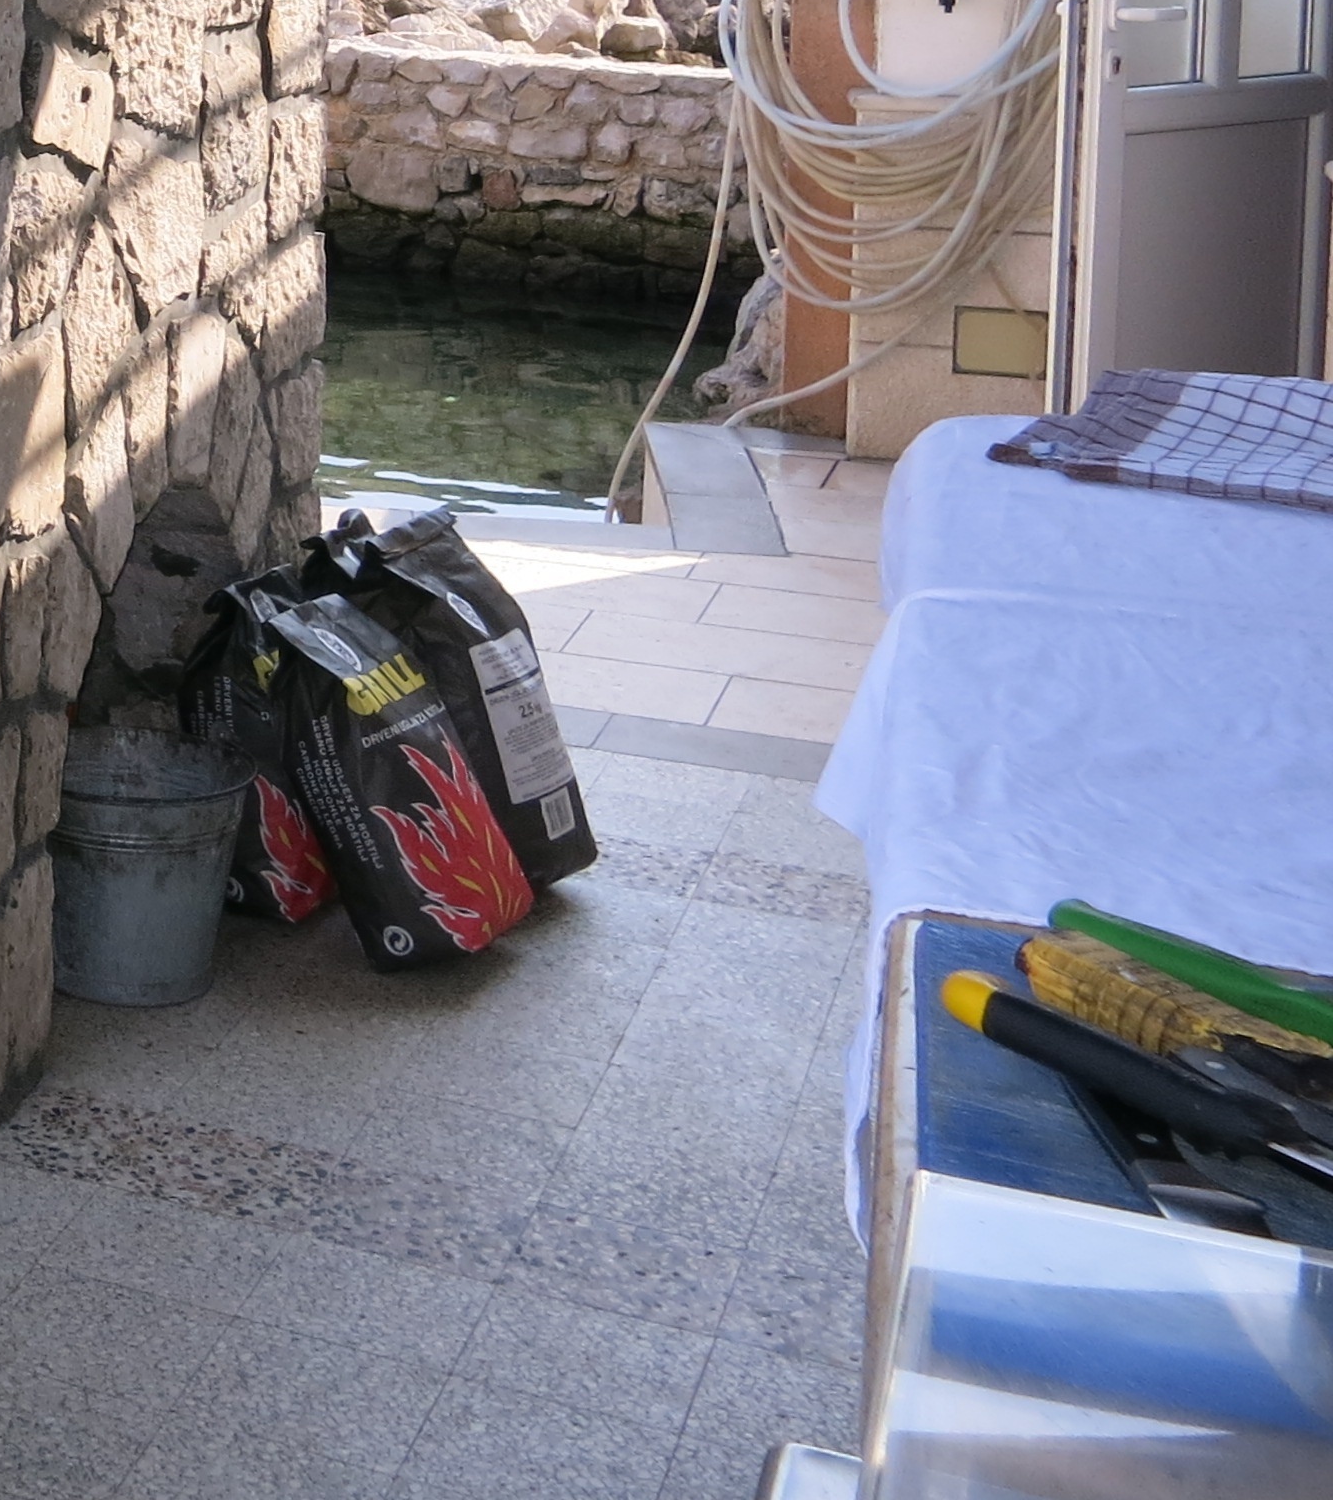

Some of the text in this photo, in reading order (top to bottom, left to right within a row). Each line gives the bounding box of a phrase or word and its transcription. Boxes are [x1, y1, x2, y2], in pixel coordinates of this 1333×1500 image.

[342, 653, 426, 716] GRILL
[361, 723, 400, 748] DRVENI
[298, 741, 320, 795] CARBONE
[323, 812, 343, 849] LEGNA
[312, 760, 343, 827] HOLZKOHLE
[320, 715, 384, 870] DRVENI UGLJEN ZA ROŠTILJ
[336, 799, 345, 813] ZA
[344, 815, 368, 862] ROŠTILJ
